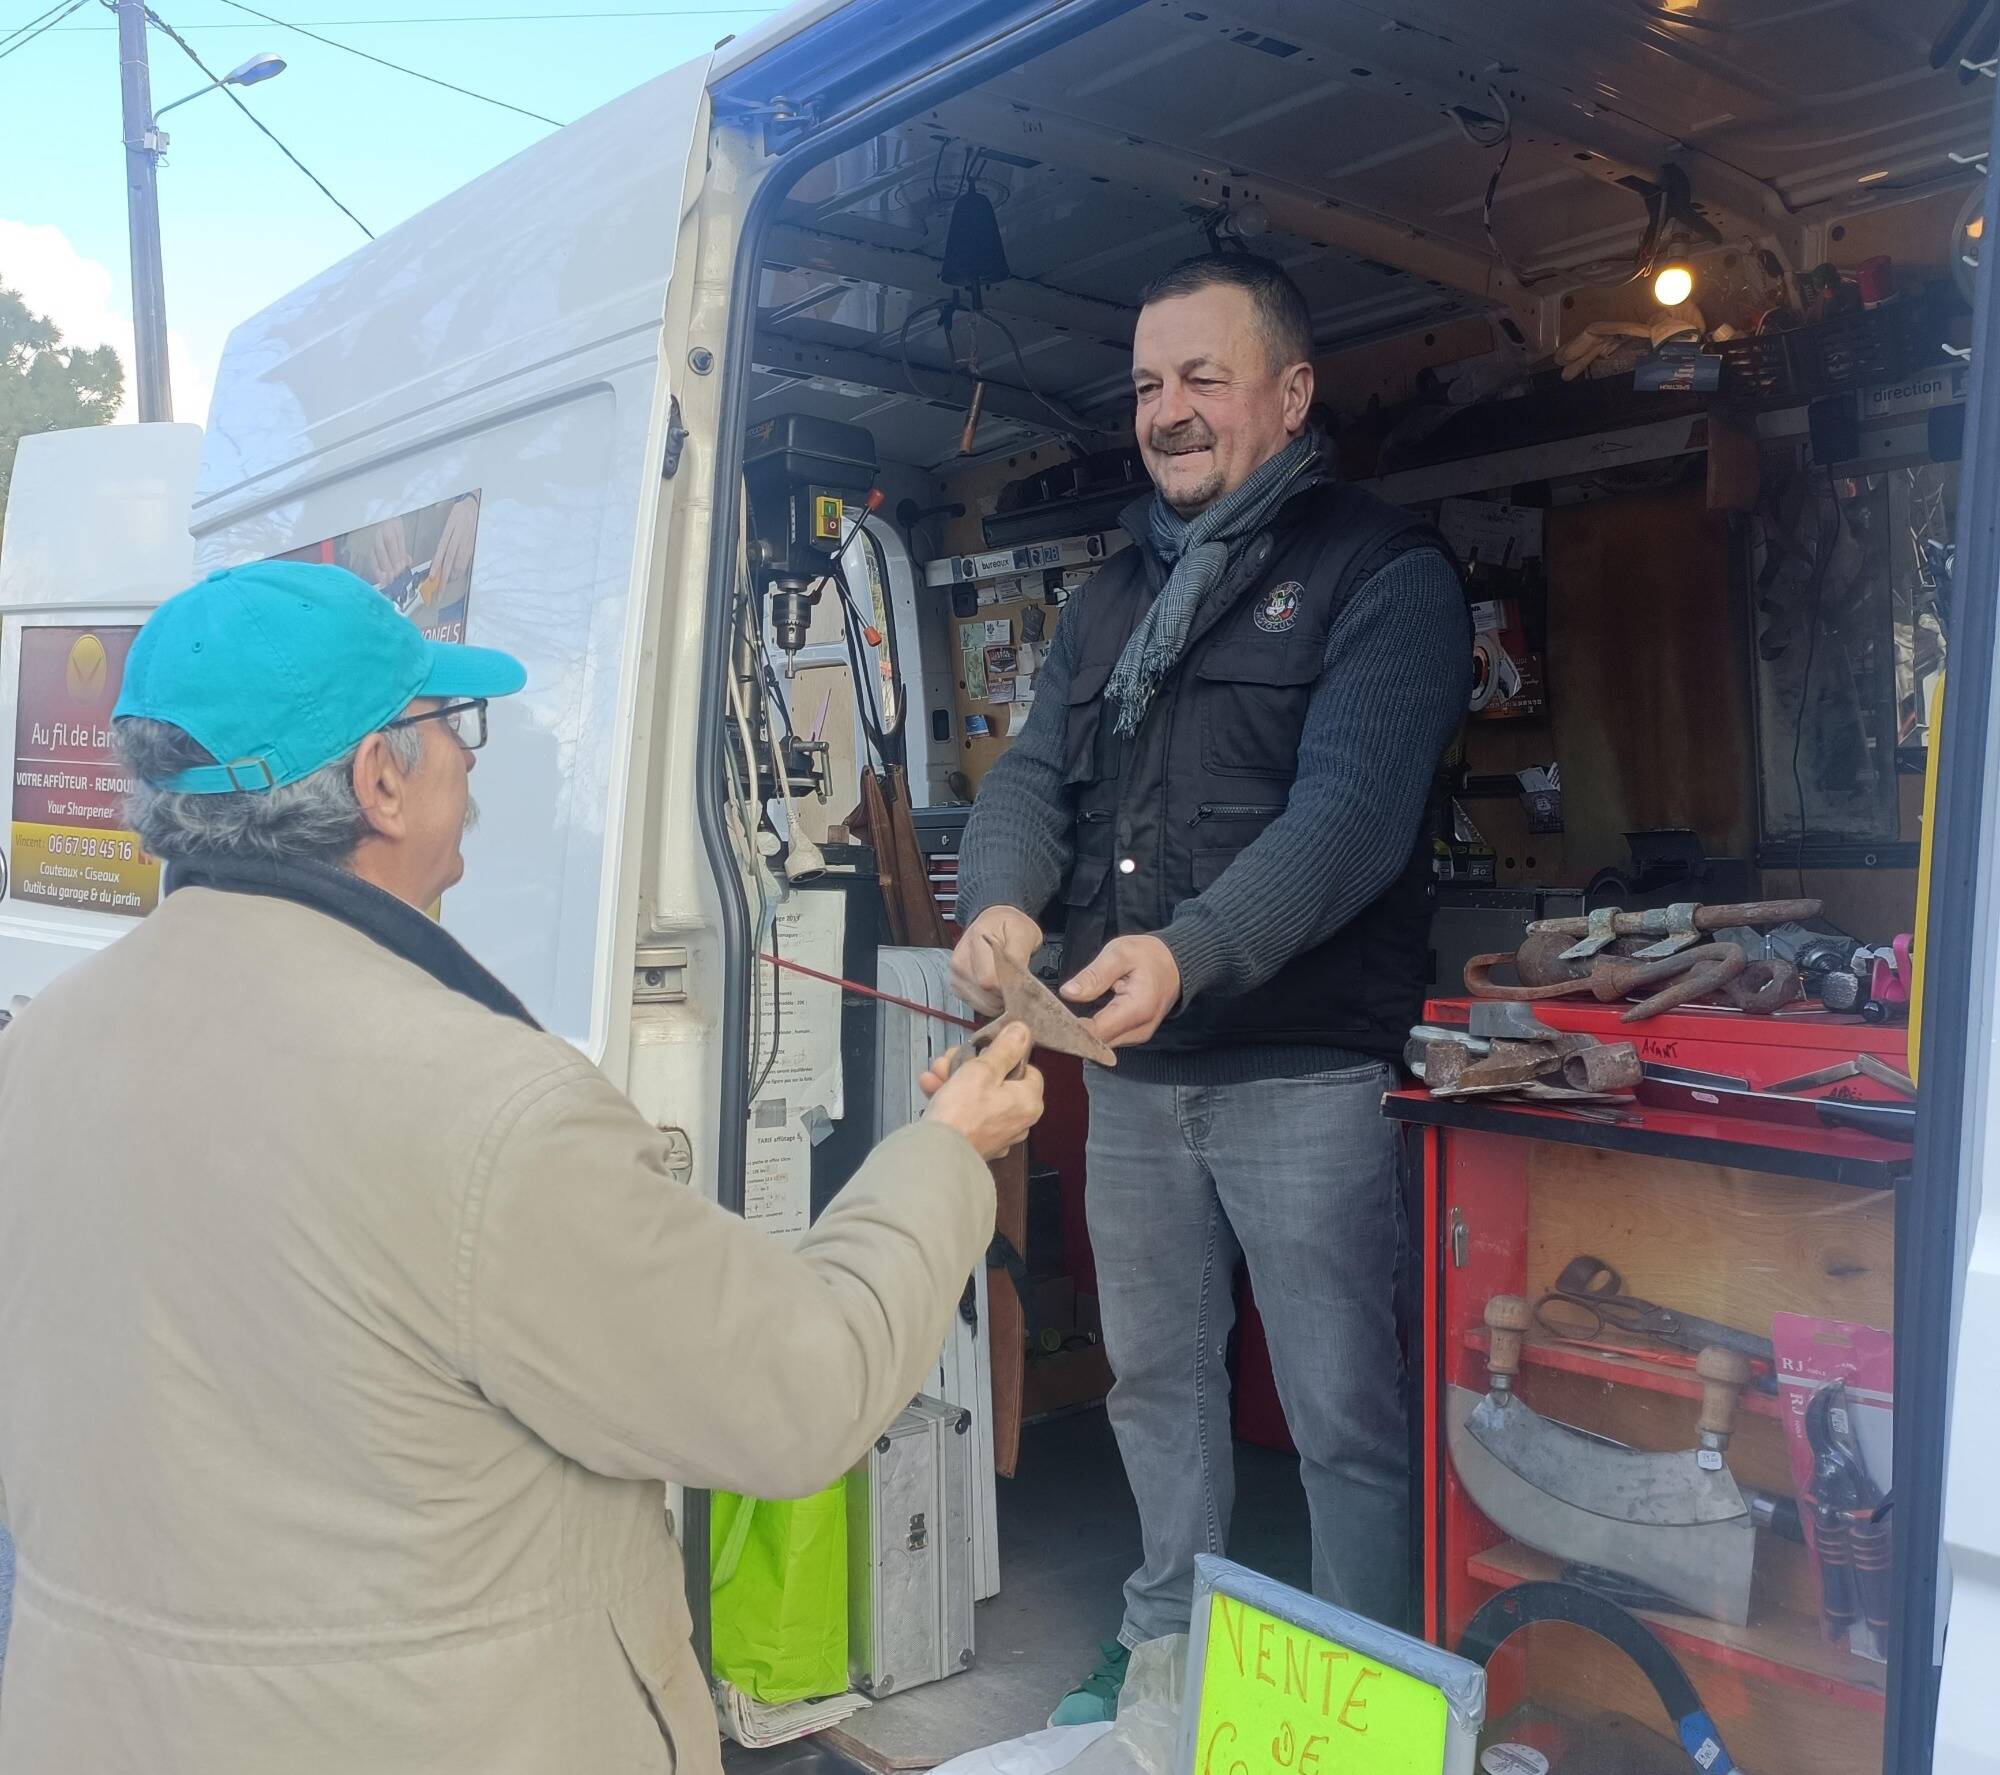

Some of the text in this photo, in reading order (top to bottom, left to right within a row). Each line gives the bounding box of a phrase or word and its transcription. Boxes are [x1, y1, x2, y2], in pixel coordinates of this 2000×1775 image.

[1873, 380, 1942, 402] direction
[981, 558, 1009, 570] bureaux
[31, 722, 50, 745] Au
[49, 722, 68, 751] fil
[70, 724, 89, 747] de
[16, 771, 43, 787] VOTRE
[43, 771, 88, 790] AFFÛTEUR
[47, 800, 115, 820] Your Sharpener
[48, 834, 63, 853] 06
[65, 836, 80, 855] 67
[81, 838, 97, 857] 98
[99, 839, 116, 859] 45
[118, 841, 132, 860] 16
[40, 861, 120, 883] Couteaux Ciseaux
[23, 880, 141, 907] Outils du garage & du jardin
[1642, 1038, 1678, 1059] AVANT
[1218, 1593, 1382, 1733] VENTE
